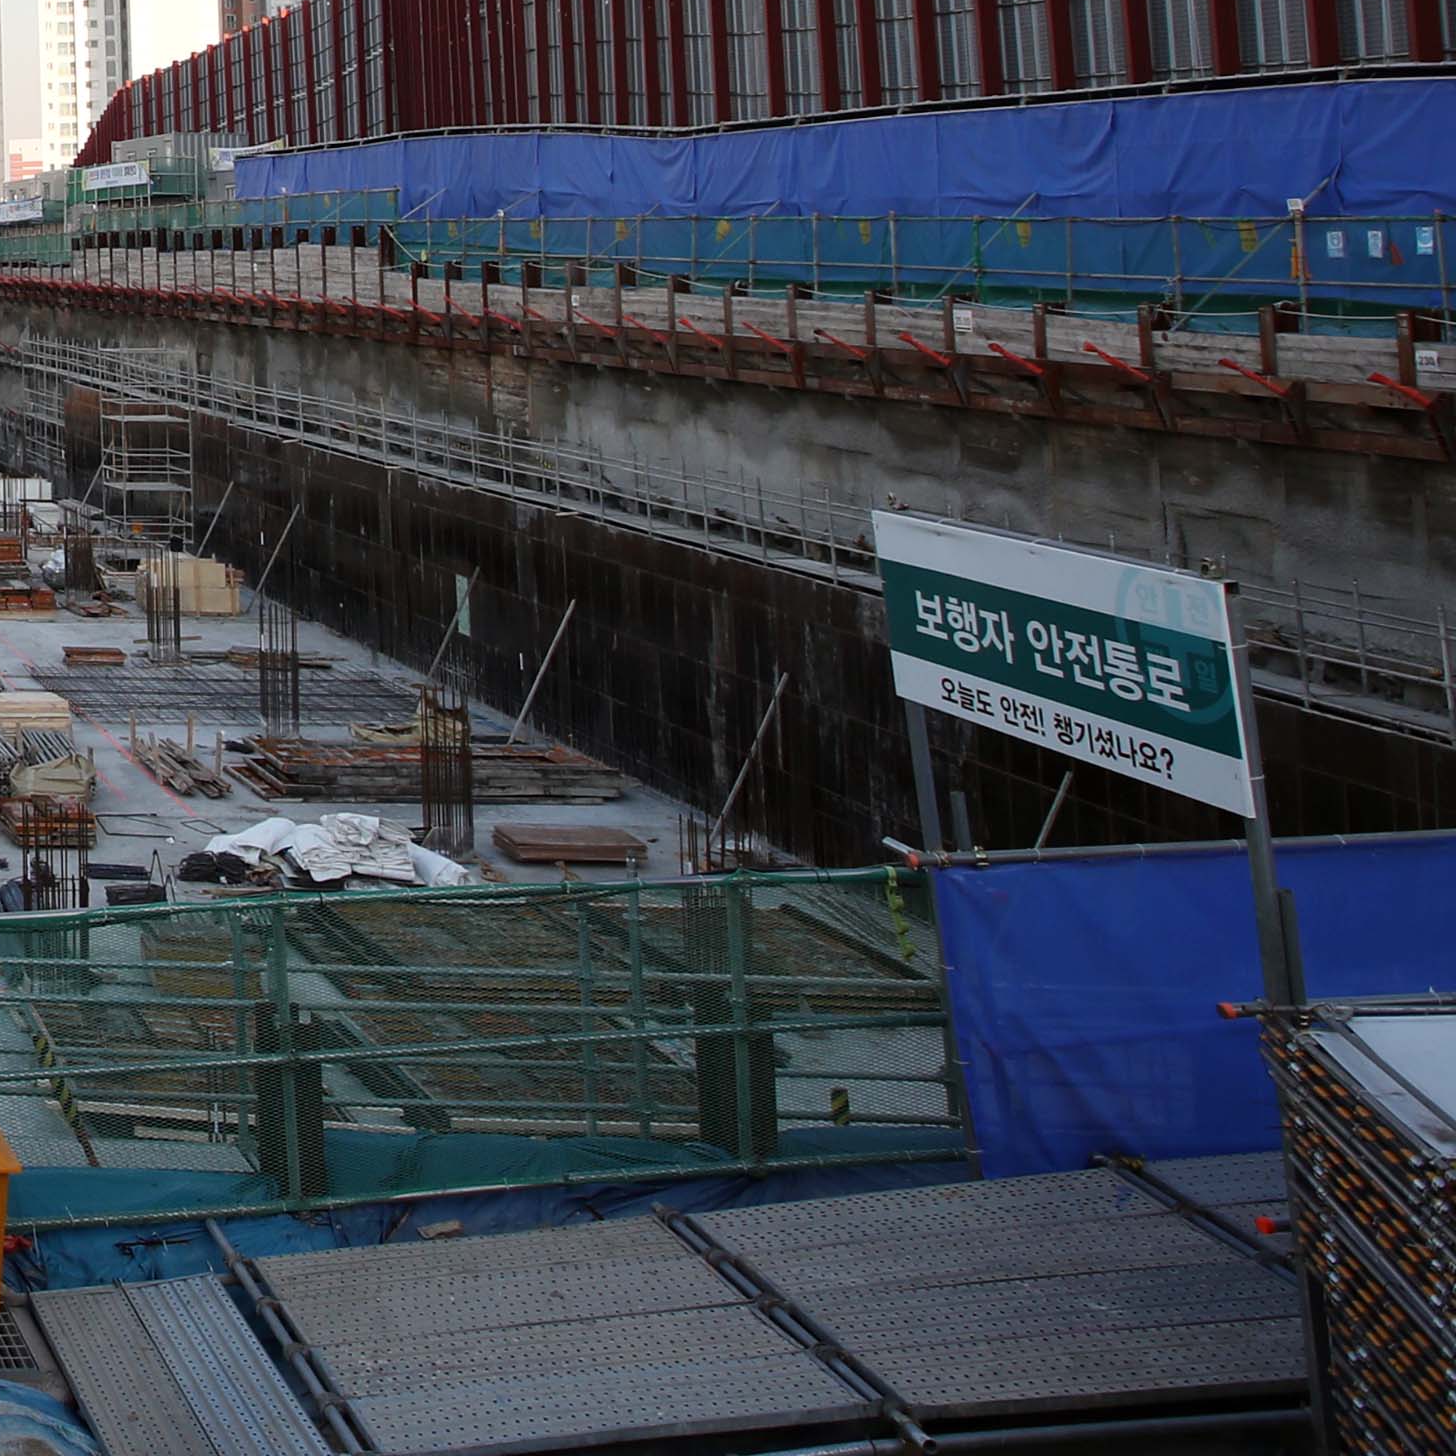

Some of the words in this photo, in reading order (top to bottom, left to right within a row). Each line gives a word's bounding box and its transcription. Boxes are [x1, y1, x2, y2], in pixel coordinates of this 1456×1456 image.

[915, 590, 1015, 665] 보행자
[1026, 620, 1192, 713] 안전통로
[940, 677, 995, 717] 오늘도
[1000, 694, 1046, 738] 안전!
[1053, 712, 1175, 780] 챙기셨나요?
